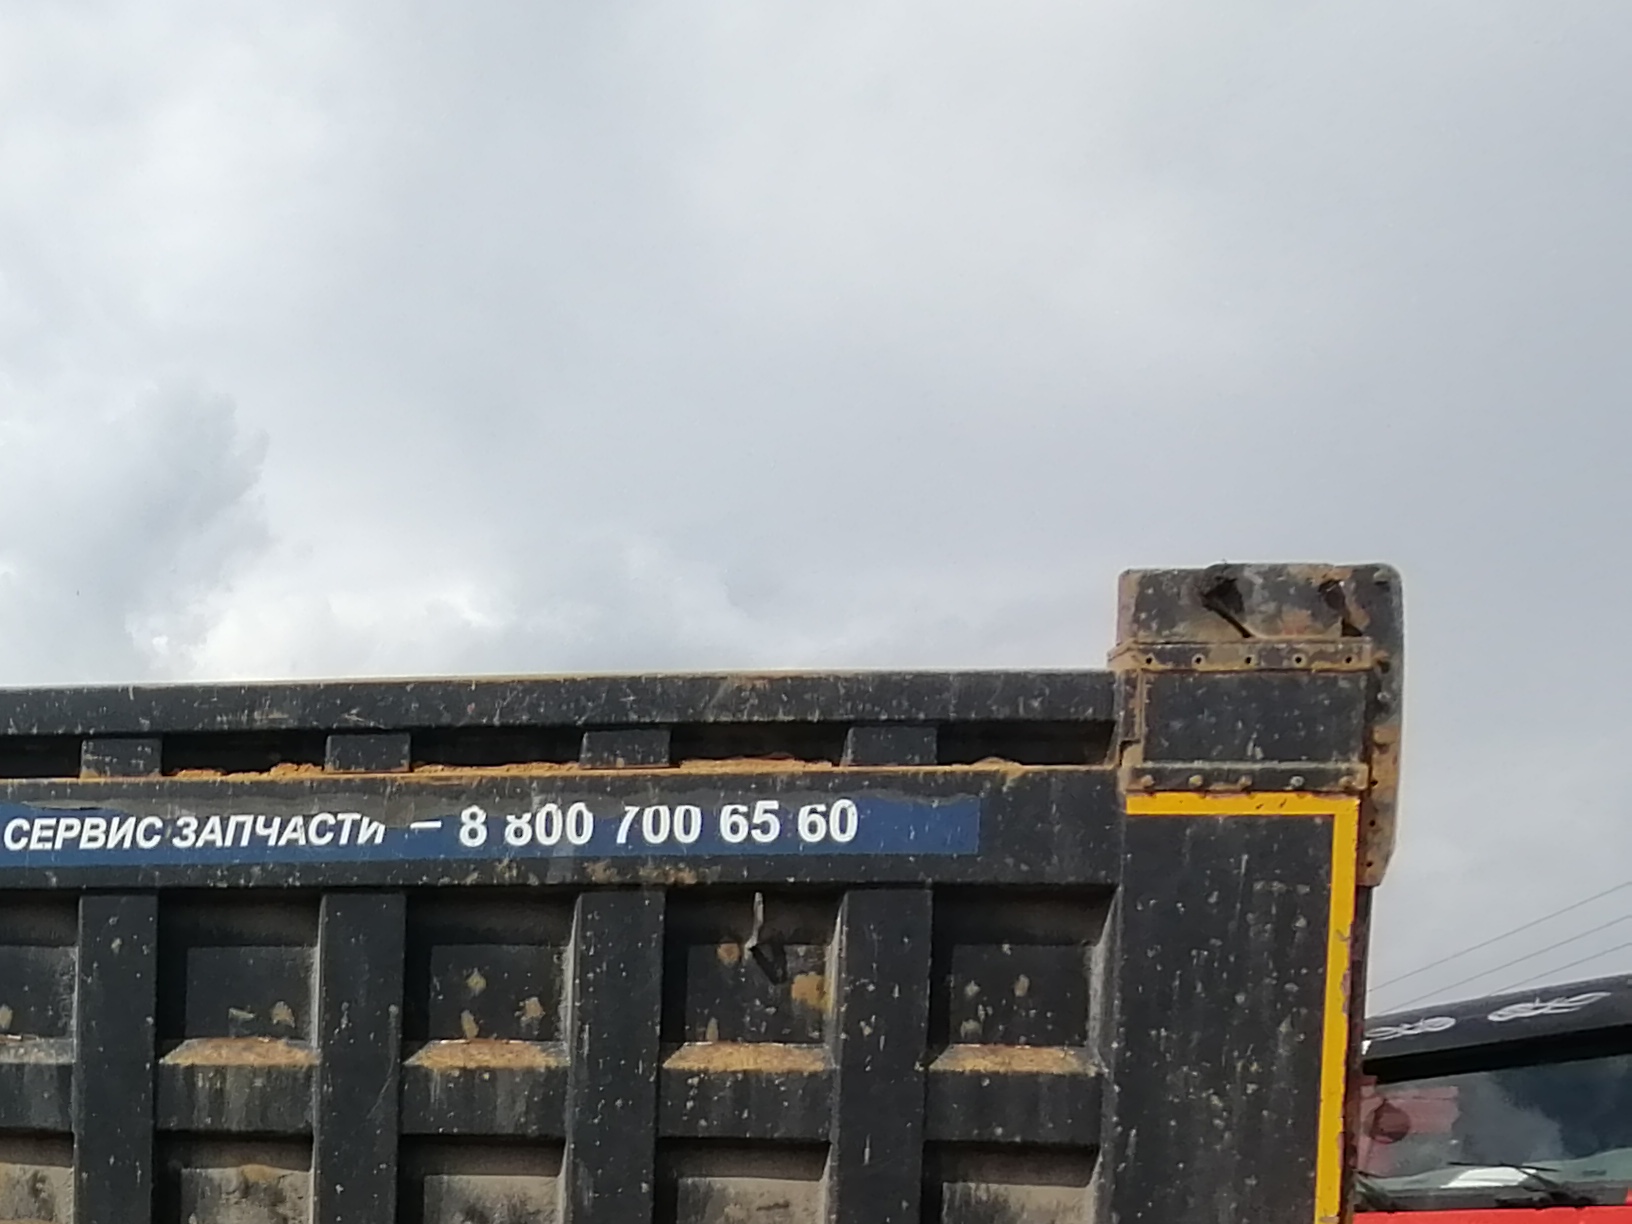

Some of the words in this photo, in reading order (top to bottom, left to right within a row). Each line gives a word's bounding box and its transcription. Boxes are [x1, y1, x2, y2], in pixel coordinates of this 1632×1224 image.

[3, 815, 164, 852] СЕРВИС
[172, 812, 386, 848] ЗАПЧАСТИ
[458, 804, 488, 848] 8
[505, 802, 595, 846] 800
[615, 805, 703, 845] 700
[719, 800, 781, 844] 65
[797, 799, 860, 843] 60
